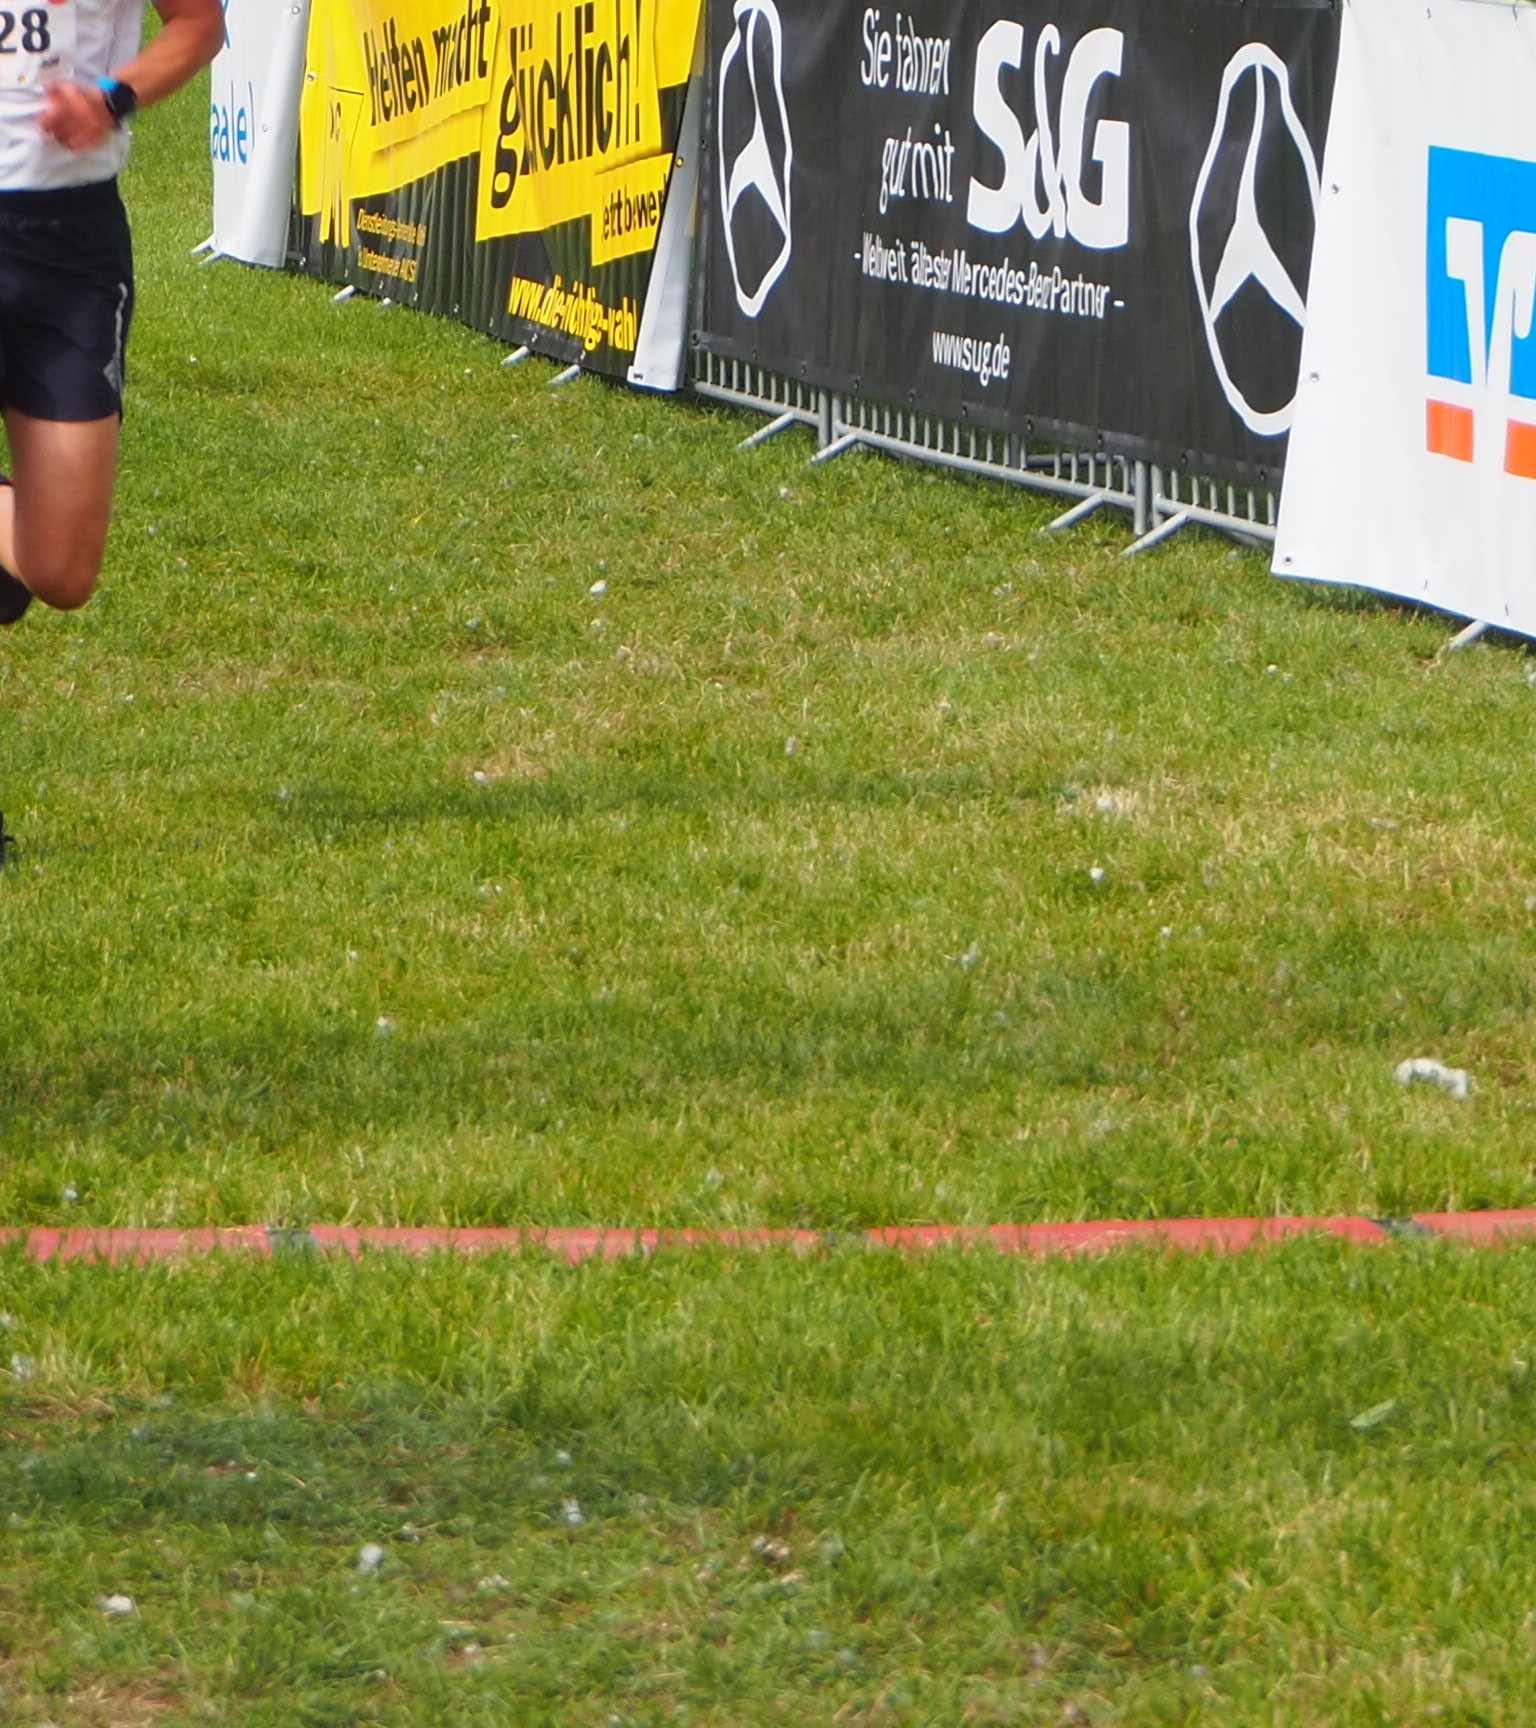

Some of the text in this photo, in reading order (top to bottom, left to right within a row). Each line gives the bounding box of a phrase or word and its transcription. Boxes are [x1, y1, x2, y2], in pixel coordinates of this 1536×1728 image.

[860, 7, 951, 96] Sie fahren
[879, 122, 955, 214] gut mit
[966, 18, 1130, 249] S&G
